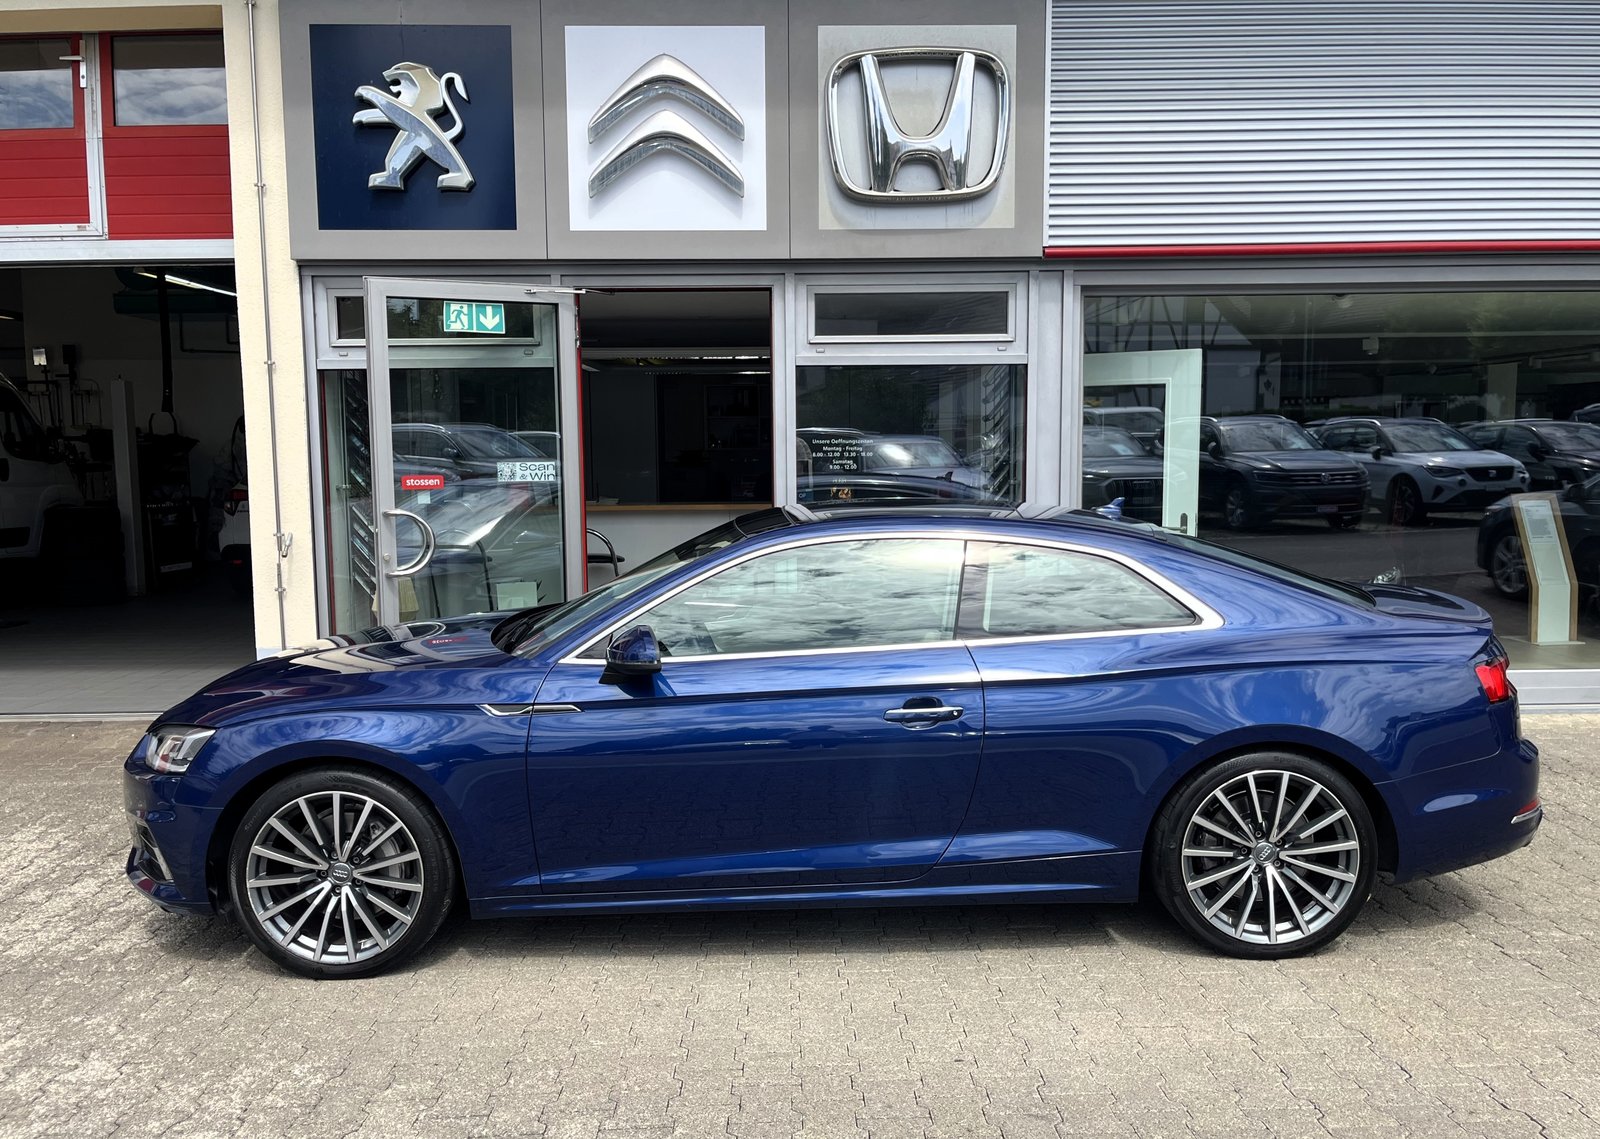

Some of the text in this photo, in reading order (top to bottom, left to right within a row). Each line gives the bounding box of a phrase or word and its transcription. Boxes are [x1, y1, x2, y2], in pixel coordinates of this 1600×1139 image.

[519, 462, 555, 471] Scan
[530, 471, 556, 480] Win
[406, 478, 440, 486] stossen
